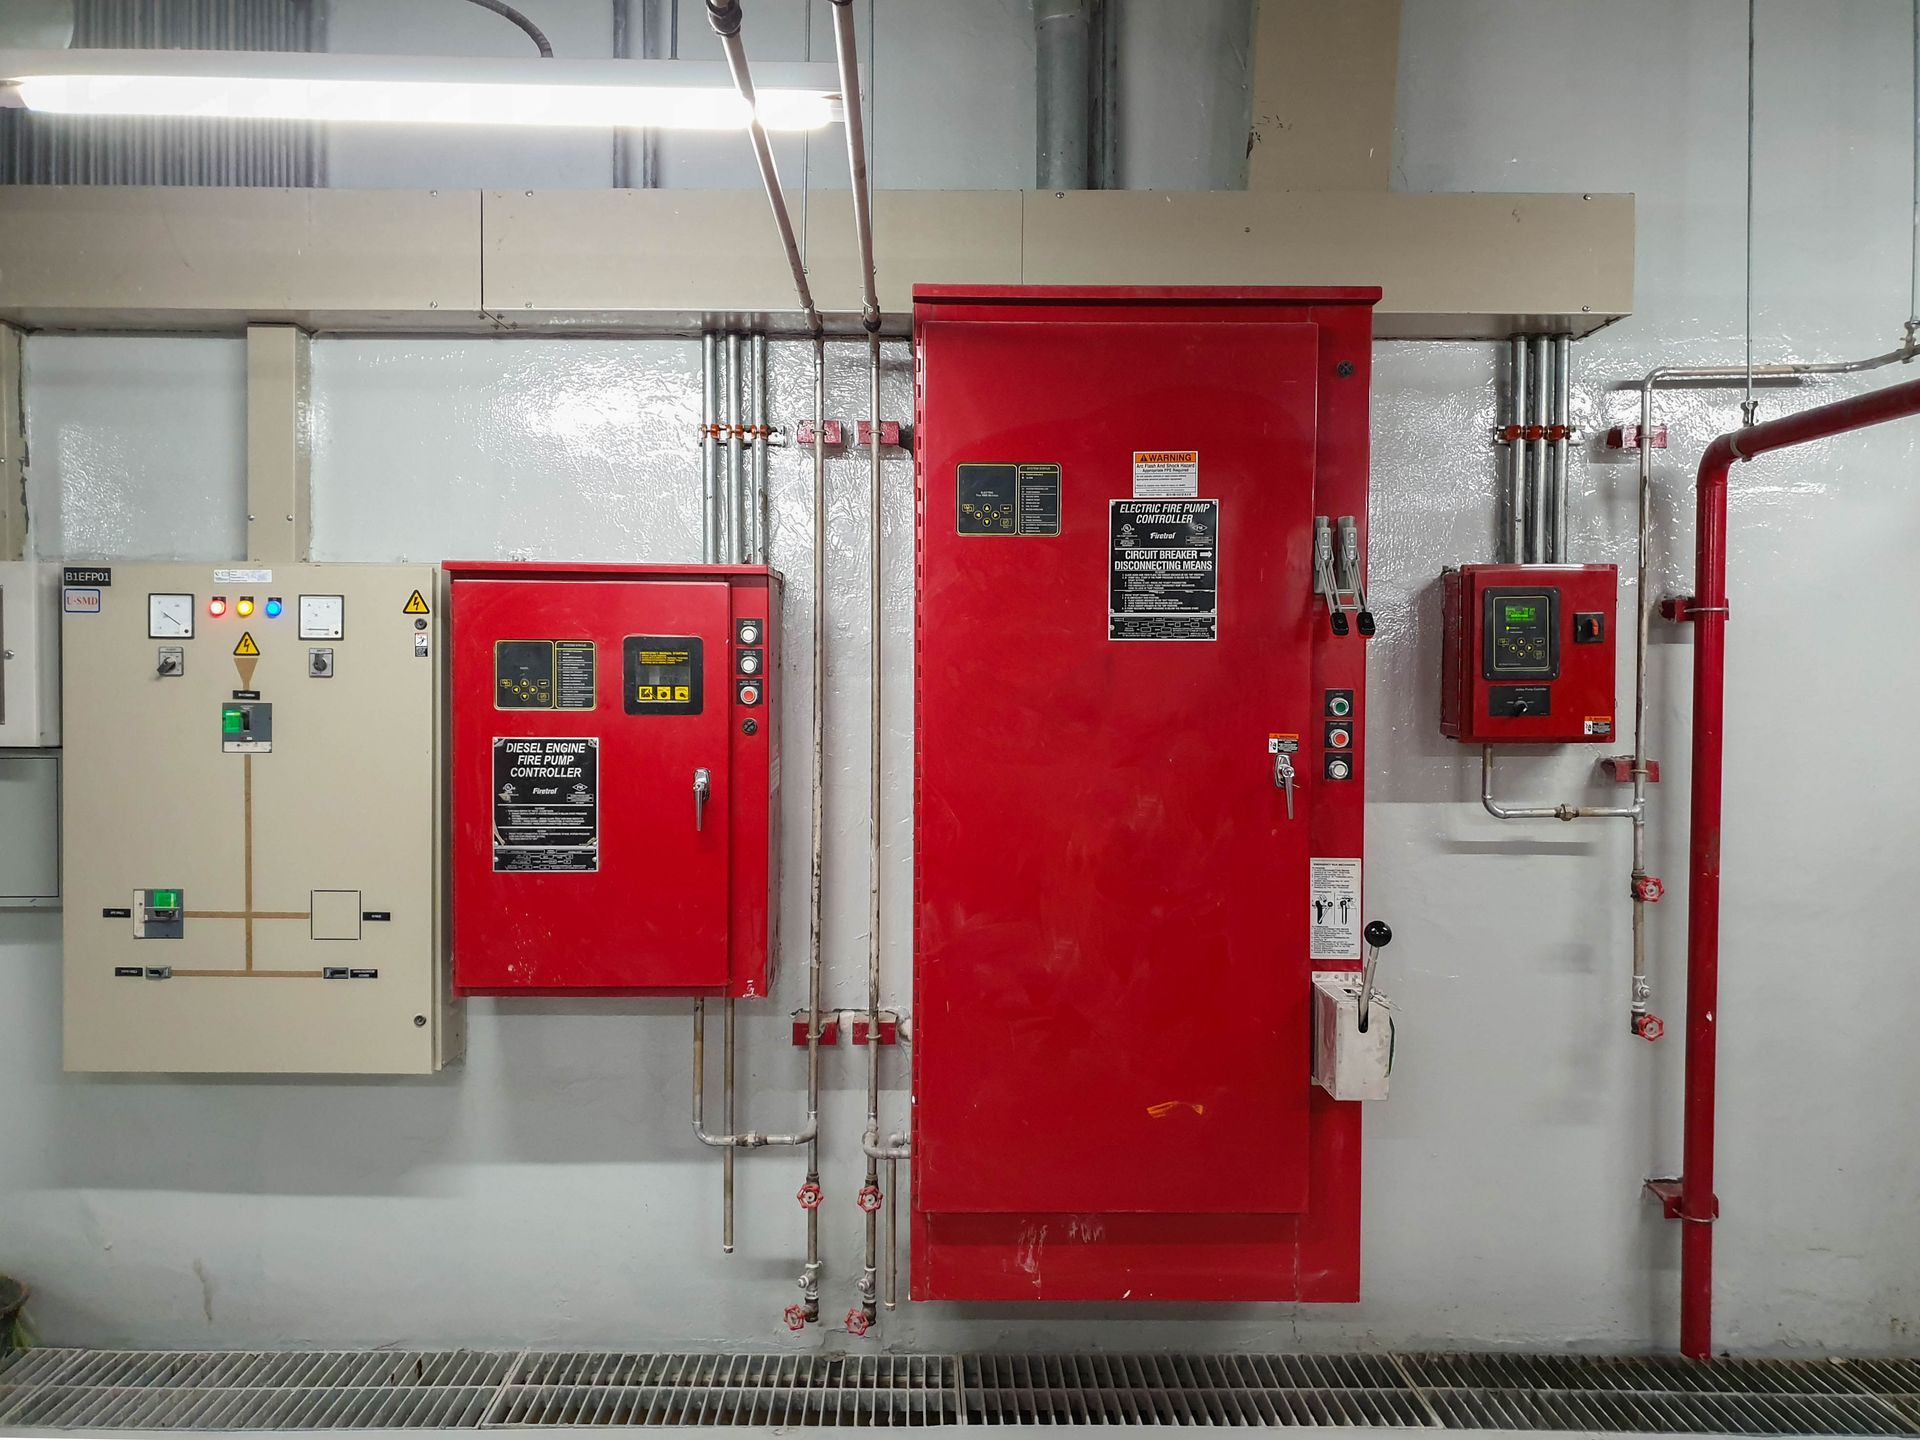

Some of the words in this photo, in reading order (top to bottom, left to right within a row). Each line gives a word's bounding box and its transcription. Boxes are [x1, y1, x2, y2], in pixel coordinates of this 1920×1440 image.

[1148, 454, 1192, 462] WARNING
[1120, 503, 1161, 513] ELECTRIC
[1162, 503, 1183, 513] FIRE
[1184, 503, 1210, 513] PUMP
[1136, 514, 1193, 524] CONTROLLER
[1149, 531, 1176, 540] Firetrol
[1125, 550, 1158, 560] CIRCUIT
[1159, 550, 1198, 560] BREAKER
[1114, 560, 1181, 570] DISCONNECTING
[1182, 560, 1213, 570] MEANS
[65, 572, 109, 582] B1EFP01
[506, 743, 543, 753] DIESEL
[545, 743, 586, 753] ENGINE
[517, 755, 542, 765] FIRE
[543, 755, 575, 765] PUMP
[510, 767, 582, 778] CONTROLLER
[532, 786, 558, 795] Firetrol
